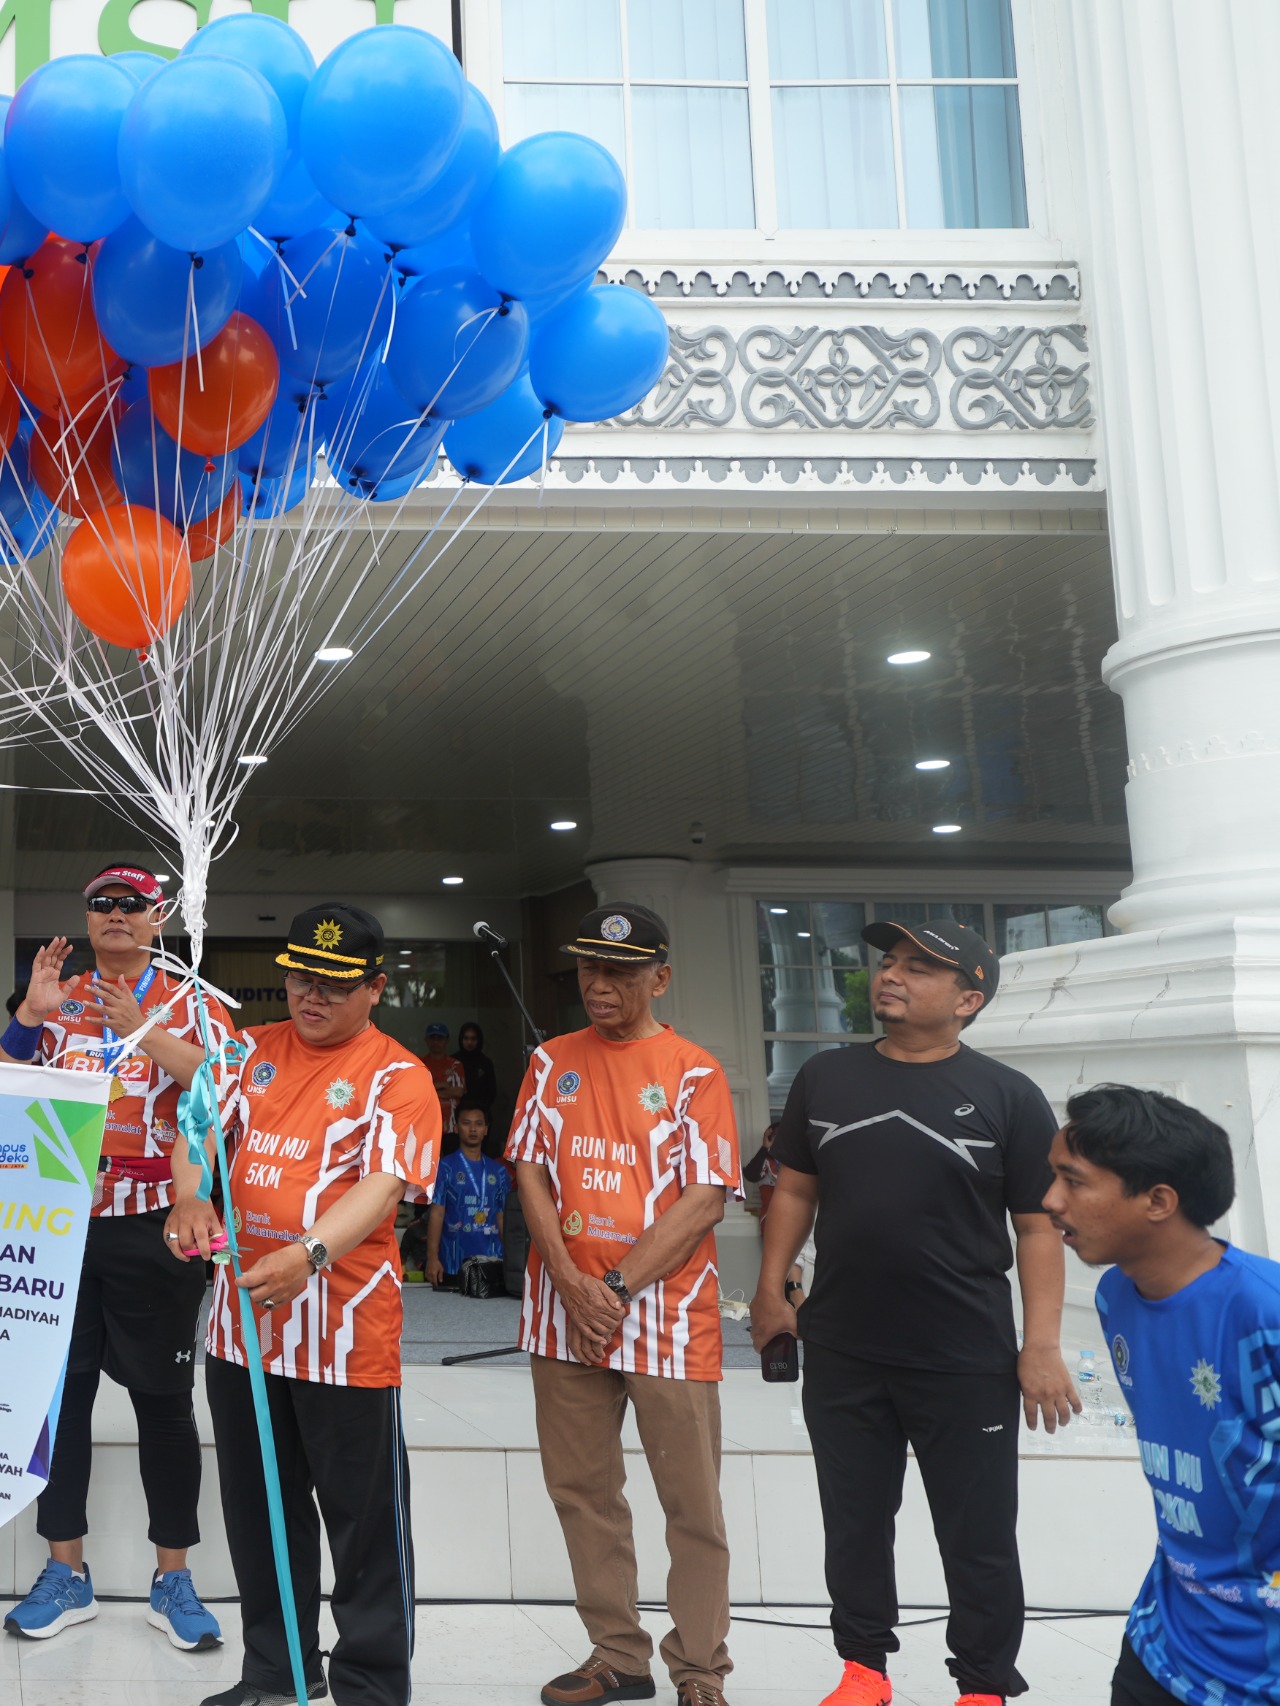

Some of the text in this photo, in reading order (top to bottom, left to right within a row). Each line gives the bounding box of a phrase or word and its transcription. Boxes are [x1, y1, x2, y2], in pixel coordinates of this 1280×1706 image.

[122, 870, 146, 882] Staff
[221, 987, 288, 1002] UDITO
[58, 1015, 82, 1023] UMSU
[72, 1057, 145, 1078] B122
[556, 1095, 577, 1104] UMSU
[104, 1122, 142, 1135] amalat
[246, 1128, 310, 1161] RUN MU
[570, 1135, 636, 1167] RUN MU
[244, 1162, 284, 1189] 5KM
[581, 1167, 622, 1194] 5KM
[246, 1210, 271, 1225] Bank
[588, 1213, 616, 1228] Bank
[246, 1223, 301, 1243] Muamalat
[587, 1226, 638, 1245] Muamala
[1139, 1438, 1203, 1494] UN MU
